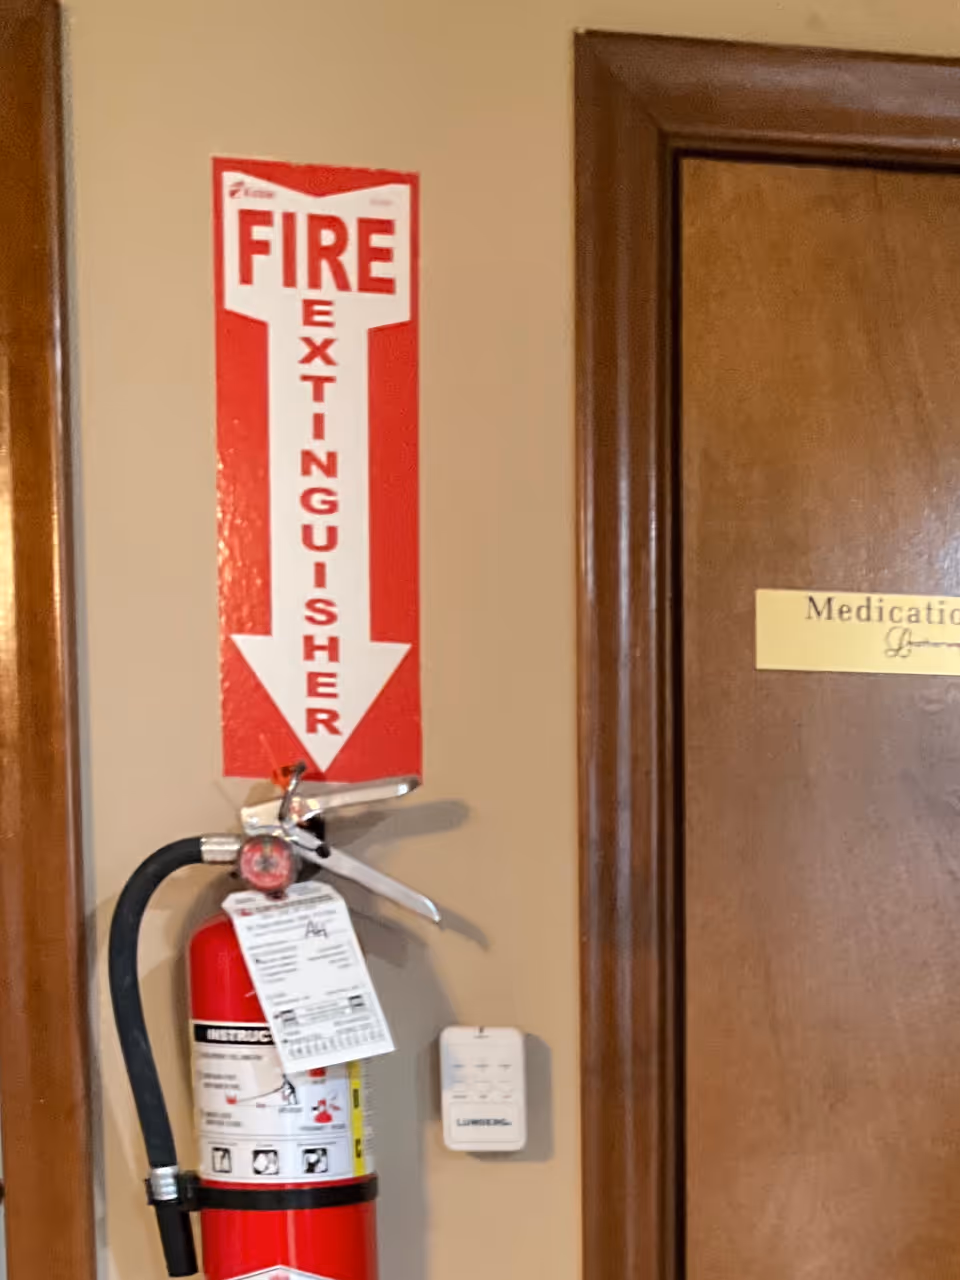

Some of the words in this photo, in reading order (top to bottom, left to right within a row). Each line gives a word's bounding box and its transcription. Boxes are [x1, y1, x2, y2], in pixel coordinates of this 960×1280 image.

[238, 208, 396, 296] FIRE
[299, 298, 342, 735] EXTINGUISHER
[206, 1028, 274, 1043] INSTRUC
